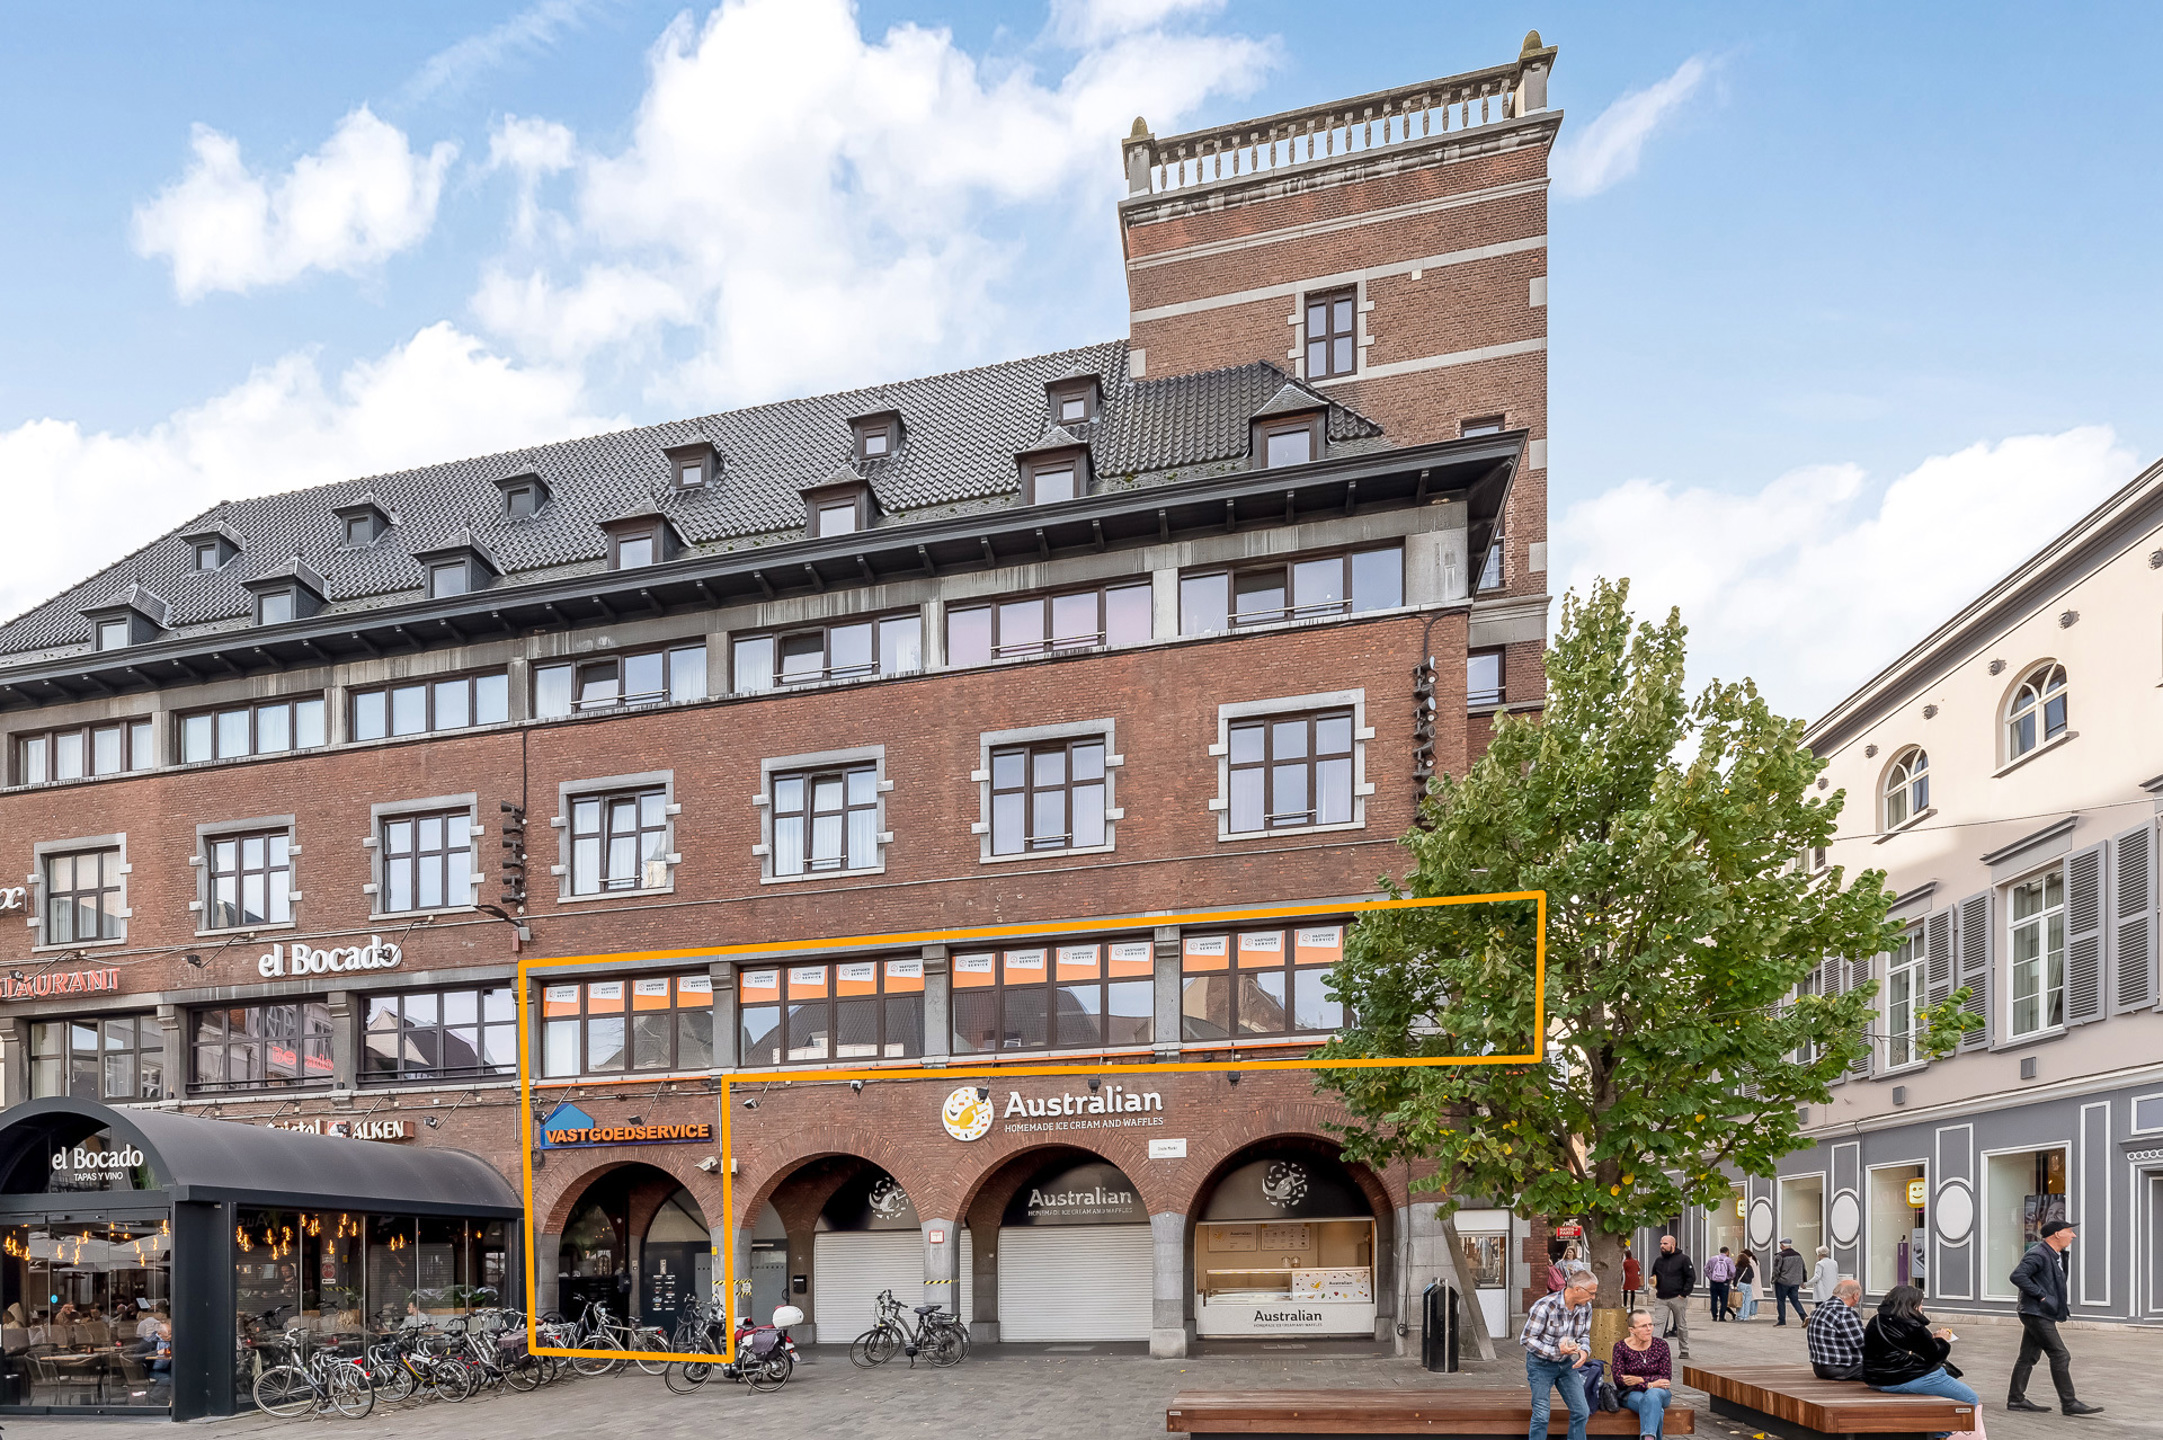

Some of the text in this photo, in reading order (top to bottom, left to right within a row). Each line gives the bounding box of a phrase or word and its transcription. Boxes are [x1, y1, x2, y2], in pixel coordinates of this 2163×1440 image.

[258, 934, 402, 978] el Bocado
[0, 967, 120, 998] TAURANT
[1003, 1085, 1164, 1119] Australian
[352, 1120, 406, 1140] ALKEN
[545, 1123, 709, 1144] VASTGOEDSERVICE
[1004, 1116, 1164, 1133] HOMEMADE ICE CREAM AND WAFFLES
[52, 1143, 144, 1170] el Bocado
[73, 1171, 124, 1182] TAPAS Y VINO
[1028, 1186, 1132, 1208] Australian
[1254, 1309, 1323, 1322] Australian
